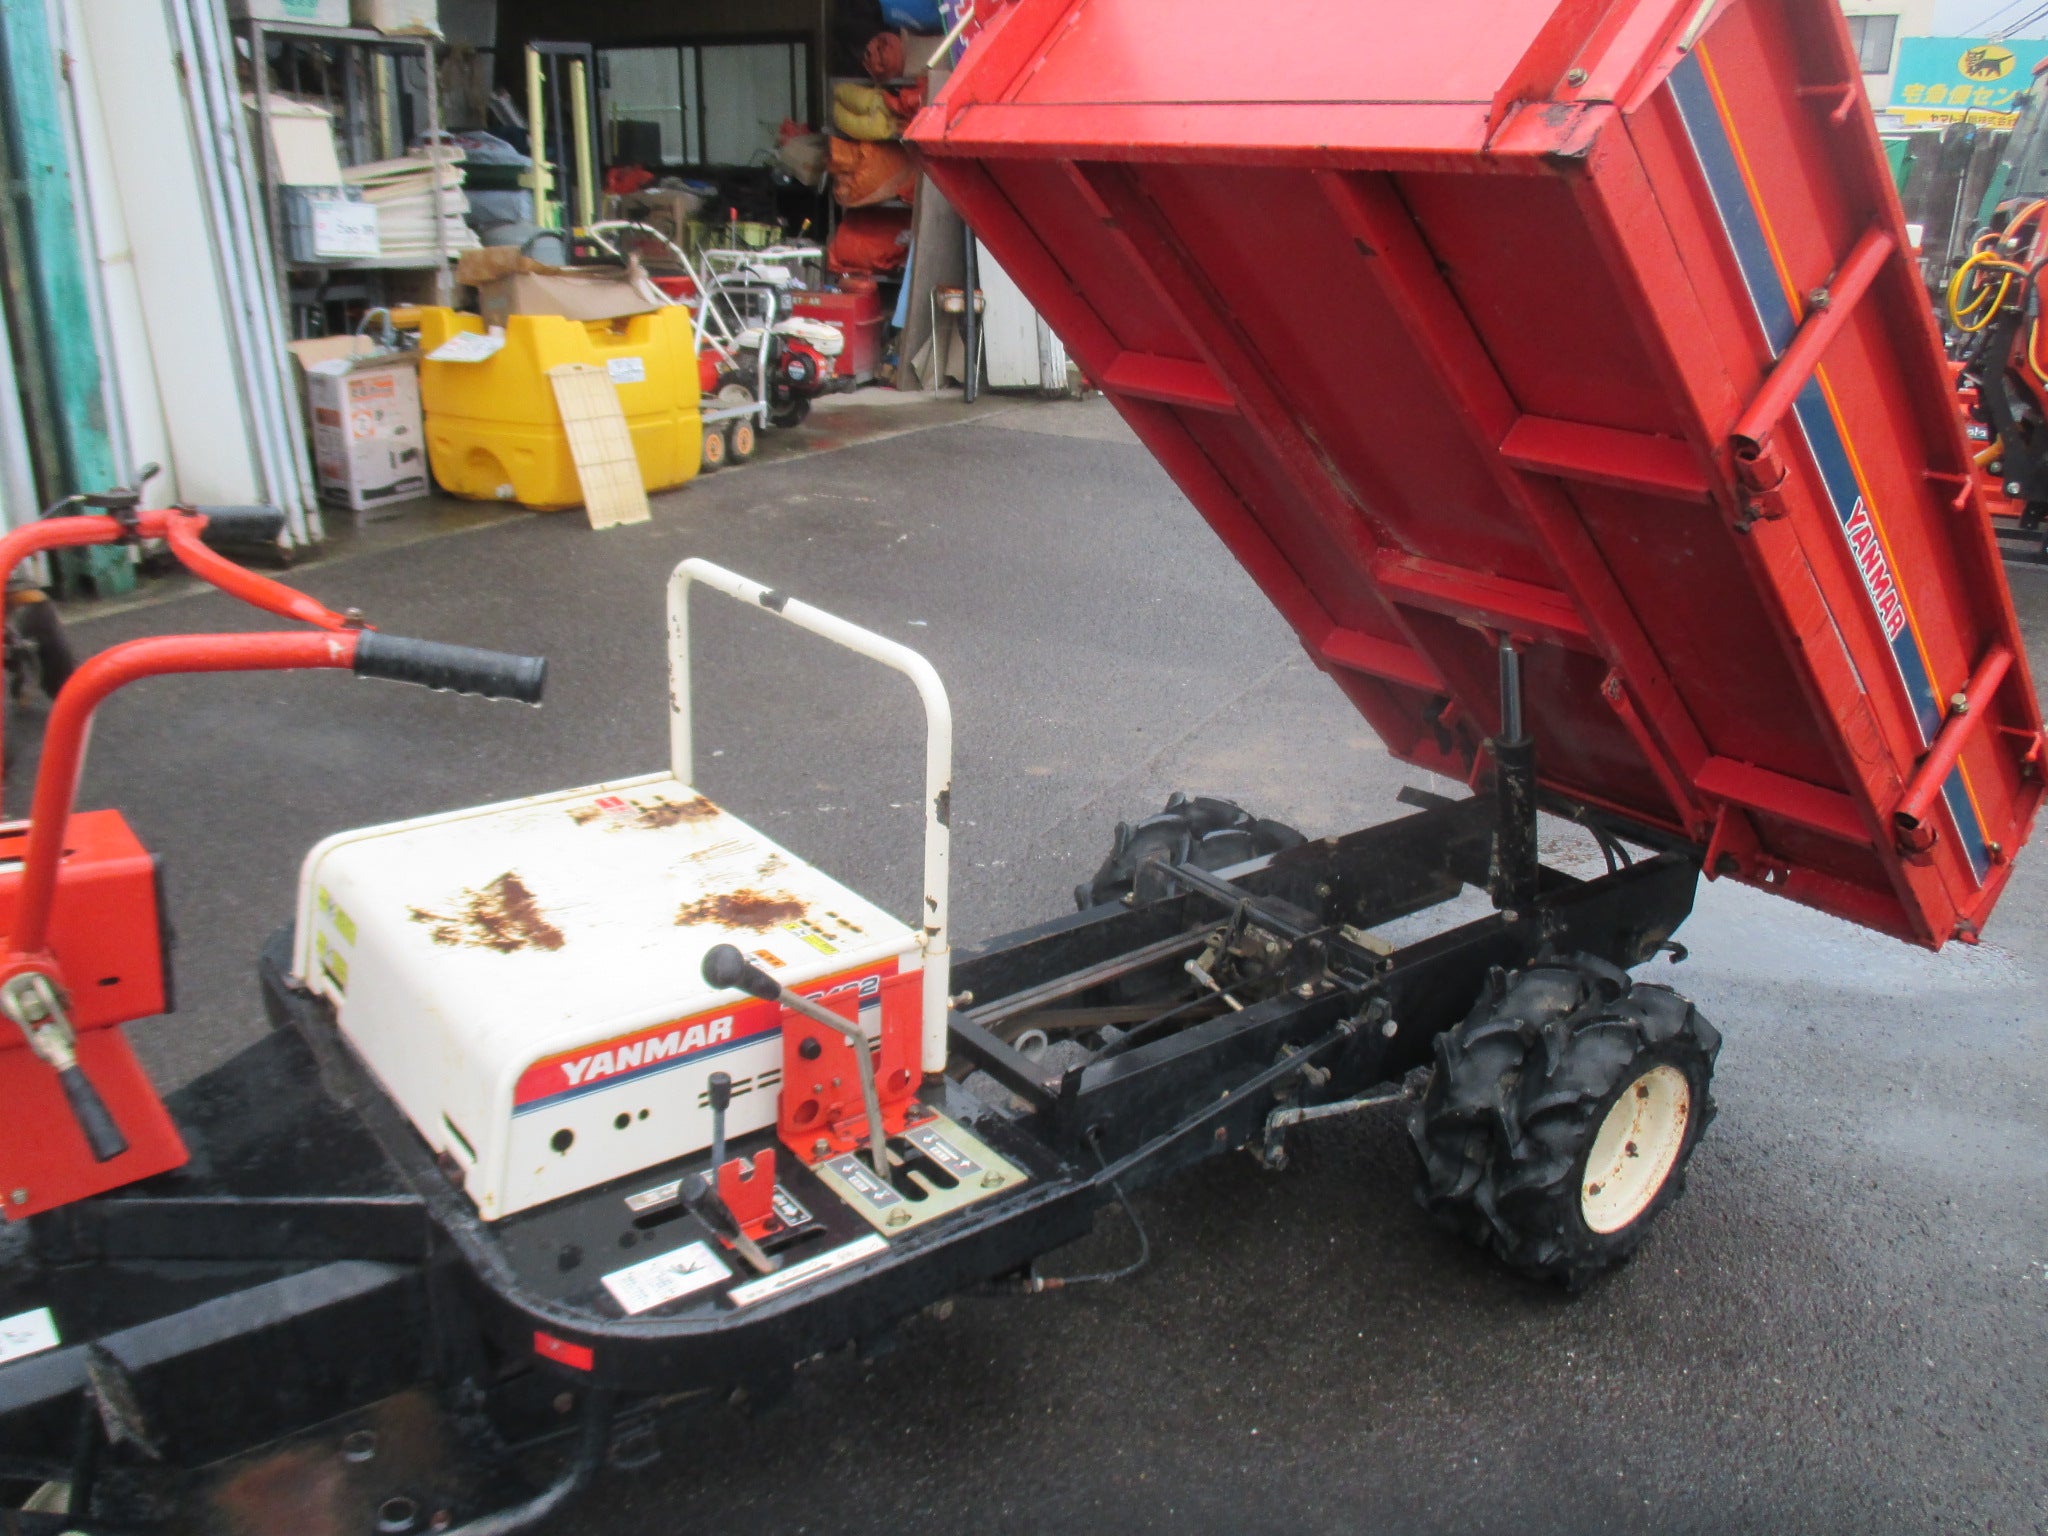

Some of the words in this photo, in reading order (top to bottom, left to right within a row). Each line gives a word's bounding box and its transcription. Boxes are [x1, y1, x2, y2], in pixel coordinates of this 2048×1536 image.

[1903, 83, 2030, 106] 宅急便セン
[1845, 496, 1905, 641] YANMAR
[561, 1017, 733, 1085] YANMAR
